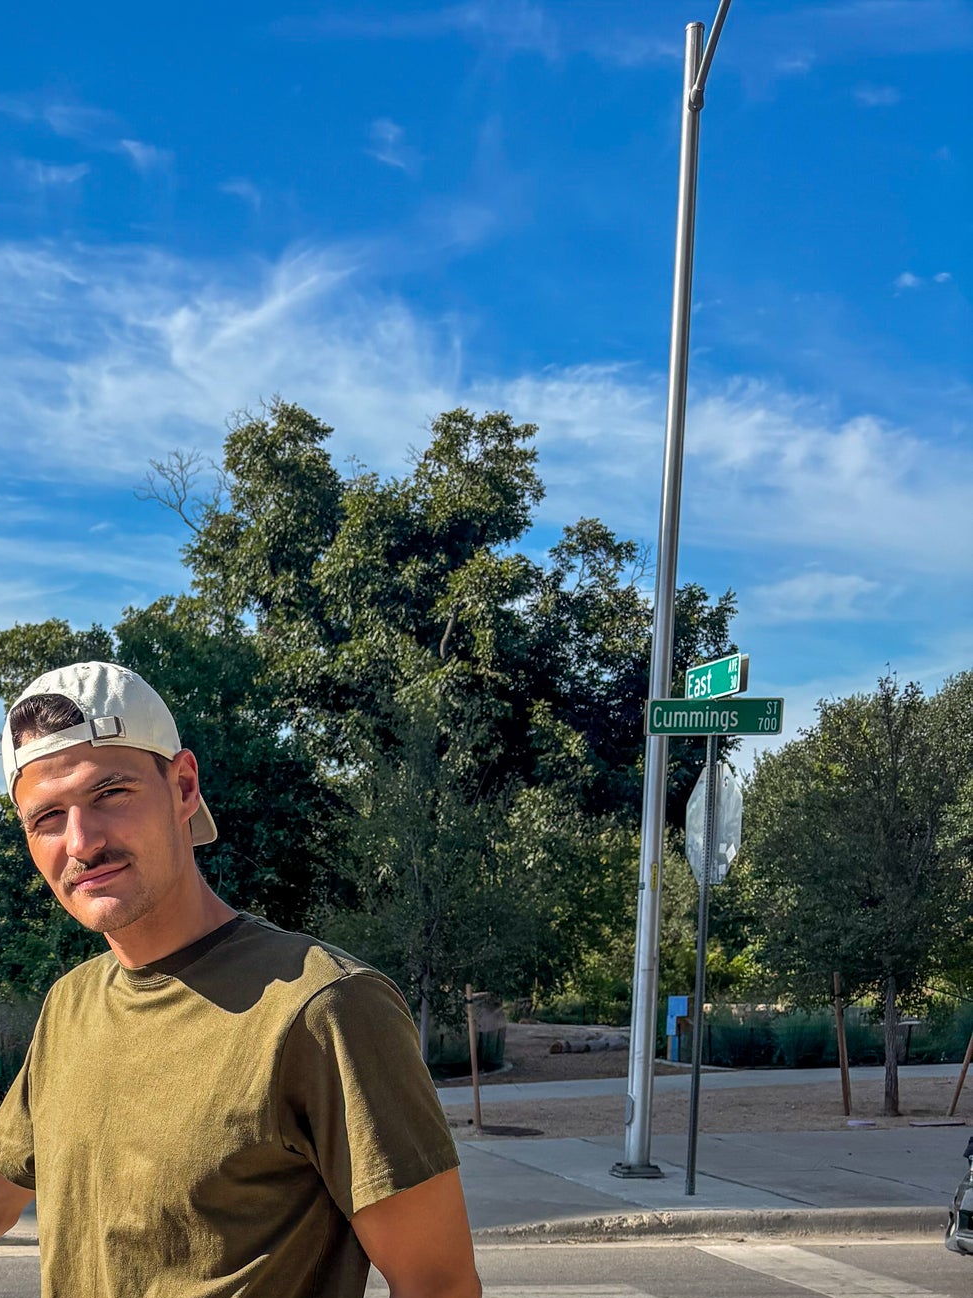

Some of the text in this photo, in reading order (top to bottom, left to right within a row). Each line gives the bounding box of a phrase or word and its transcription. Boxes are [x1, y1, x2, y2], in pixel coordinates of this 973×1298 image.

[688, 669, 712, 698] East
[766, 701, 777, 715] ST
[653, 706, 739, 731] Cummings
[758, 717, 777, 731] 700
